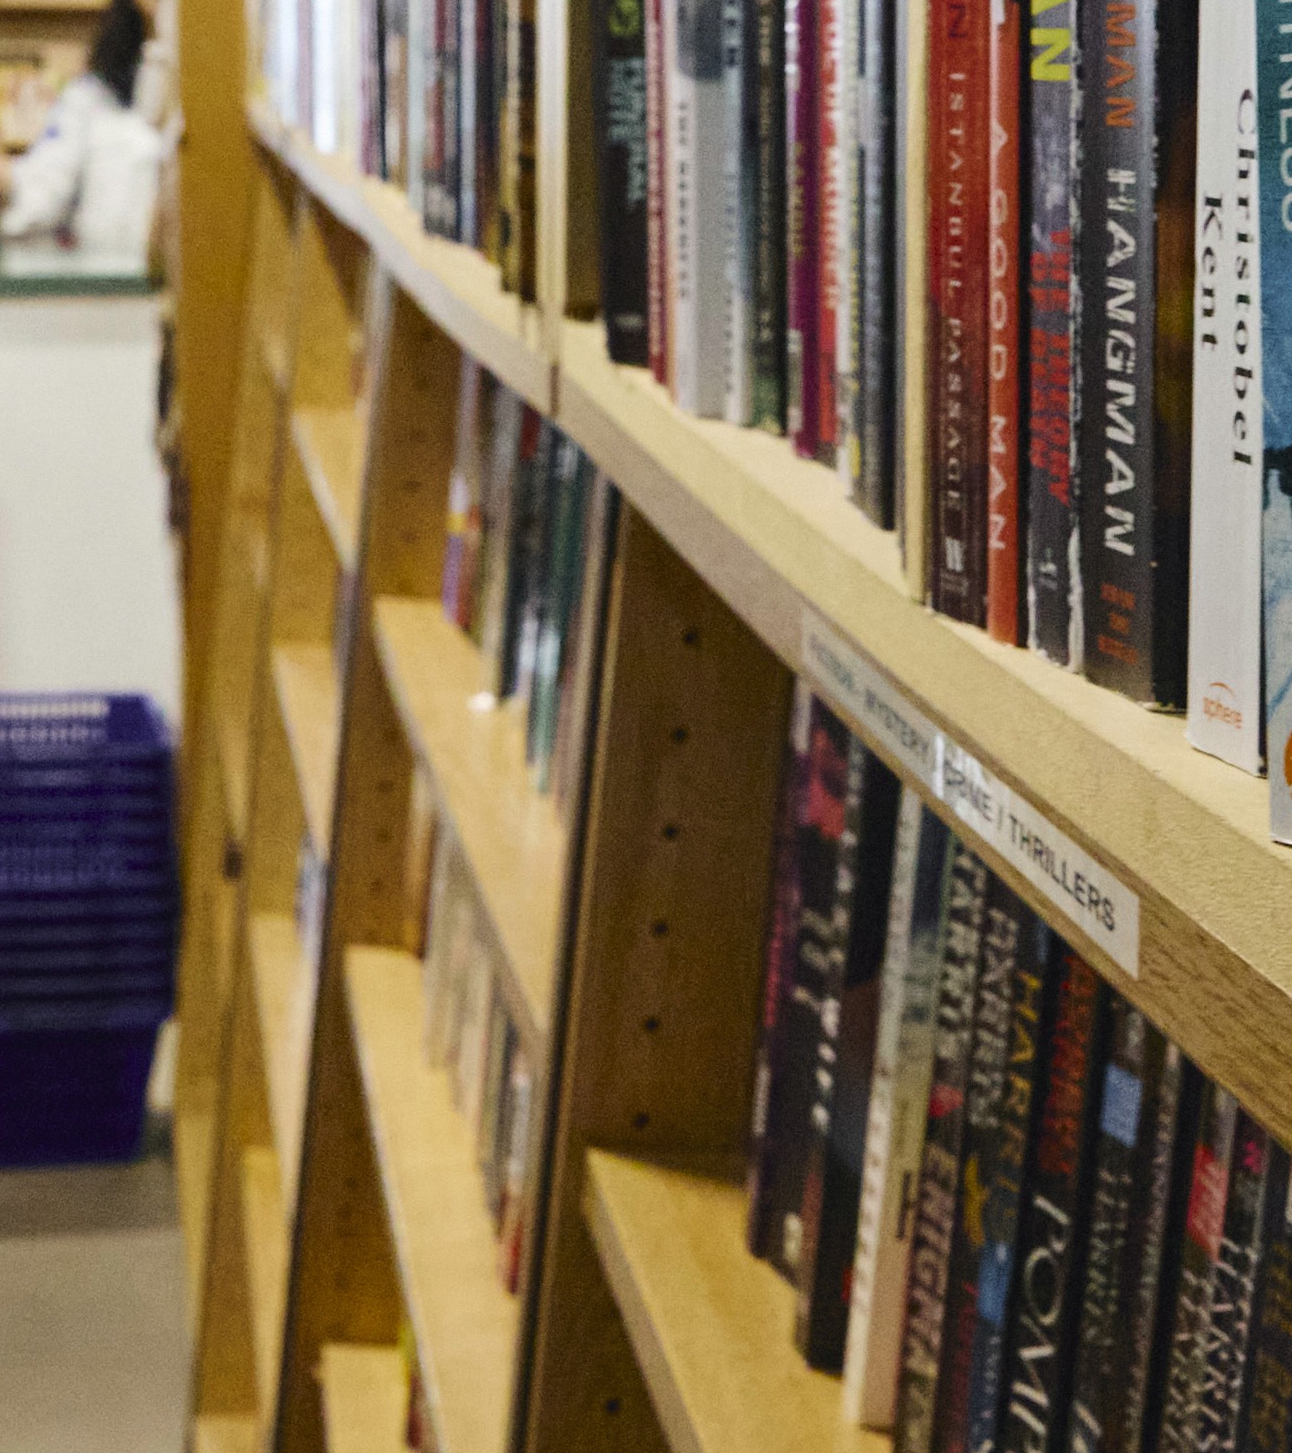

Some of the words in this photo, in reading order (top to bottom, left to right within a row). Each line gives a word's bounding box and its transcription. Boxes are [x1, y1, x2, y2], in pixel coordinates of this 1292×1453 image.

[945, 71, 965, 300] ISTANBUL
[1197, 192, 1226, 353] Kent
[1232, 89, 1256, 469] Christobel
[990, 186, 1008, 383] GOOD
[1103, 166, 1137, 559] HANGMAN
[944, 316, 964, 511] PASSAGE
[990, 412, 1008, 552] MAN
[1007, 811, 1117, 933] THRILLERS
